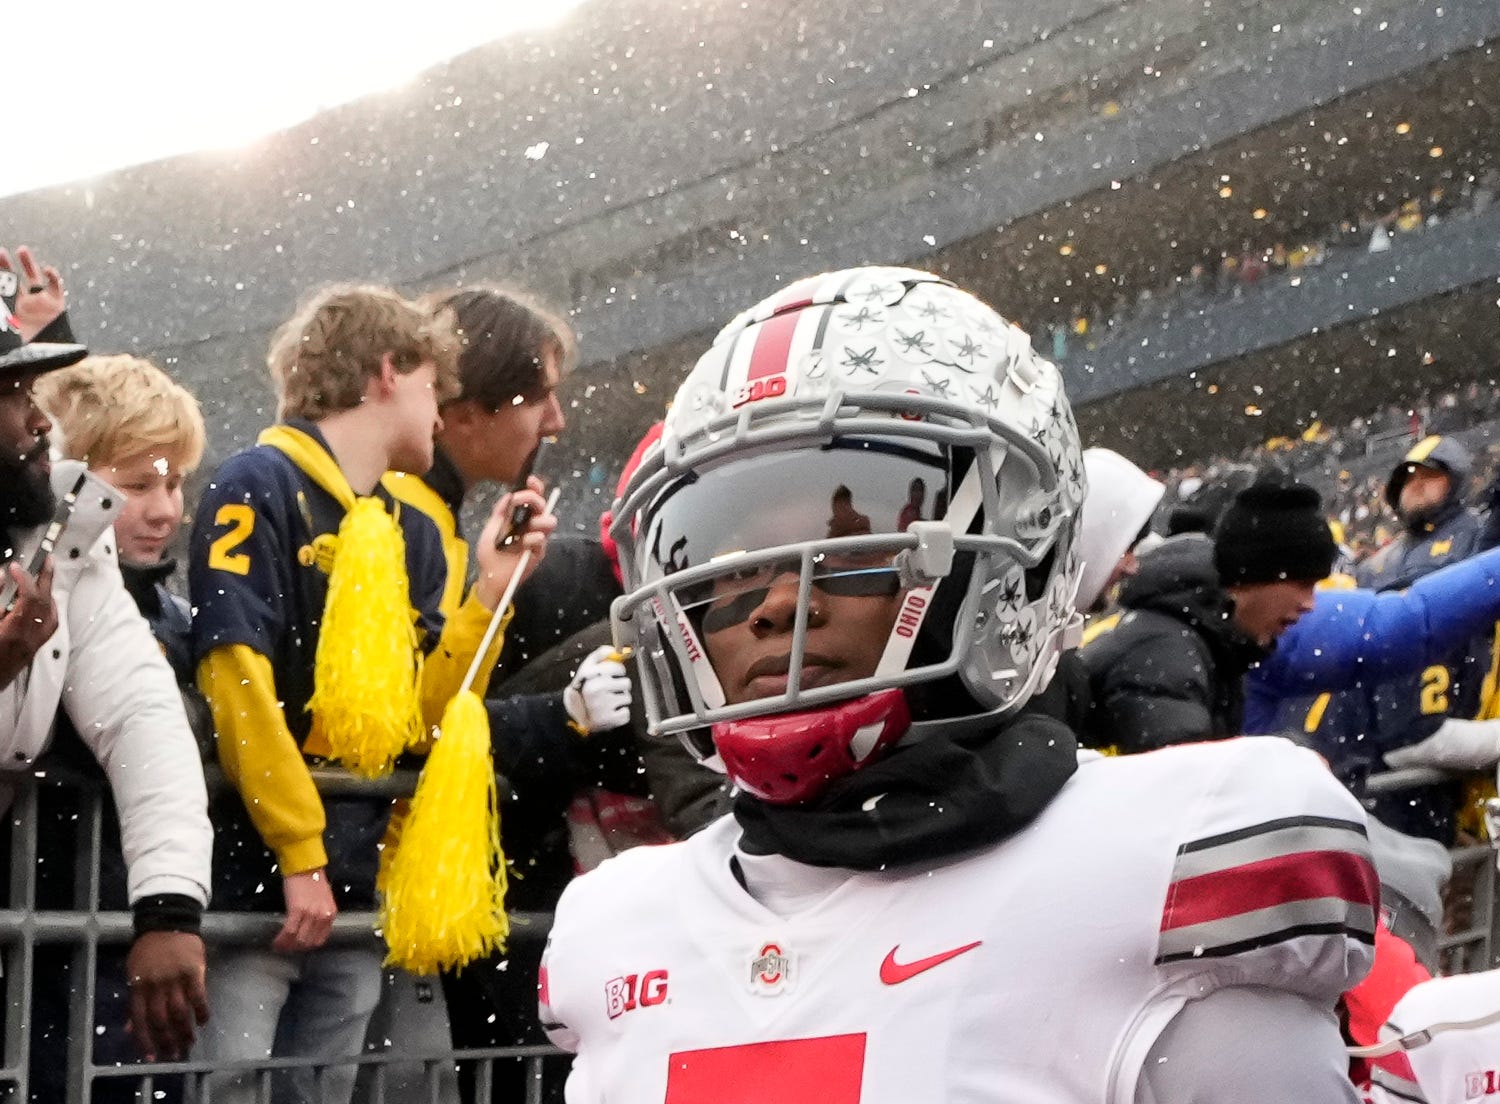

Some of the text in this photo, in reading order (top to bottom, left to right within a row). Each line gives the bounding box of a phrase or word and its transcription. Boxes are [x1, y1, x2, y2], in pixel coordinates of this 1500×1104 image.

[208, 503, 256, 577] 2
[895, 595, 926, 639] OHIO
[1420, 664, 1450, 716] 2
